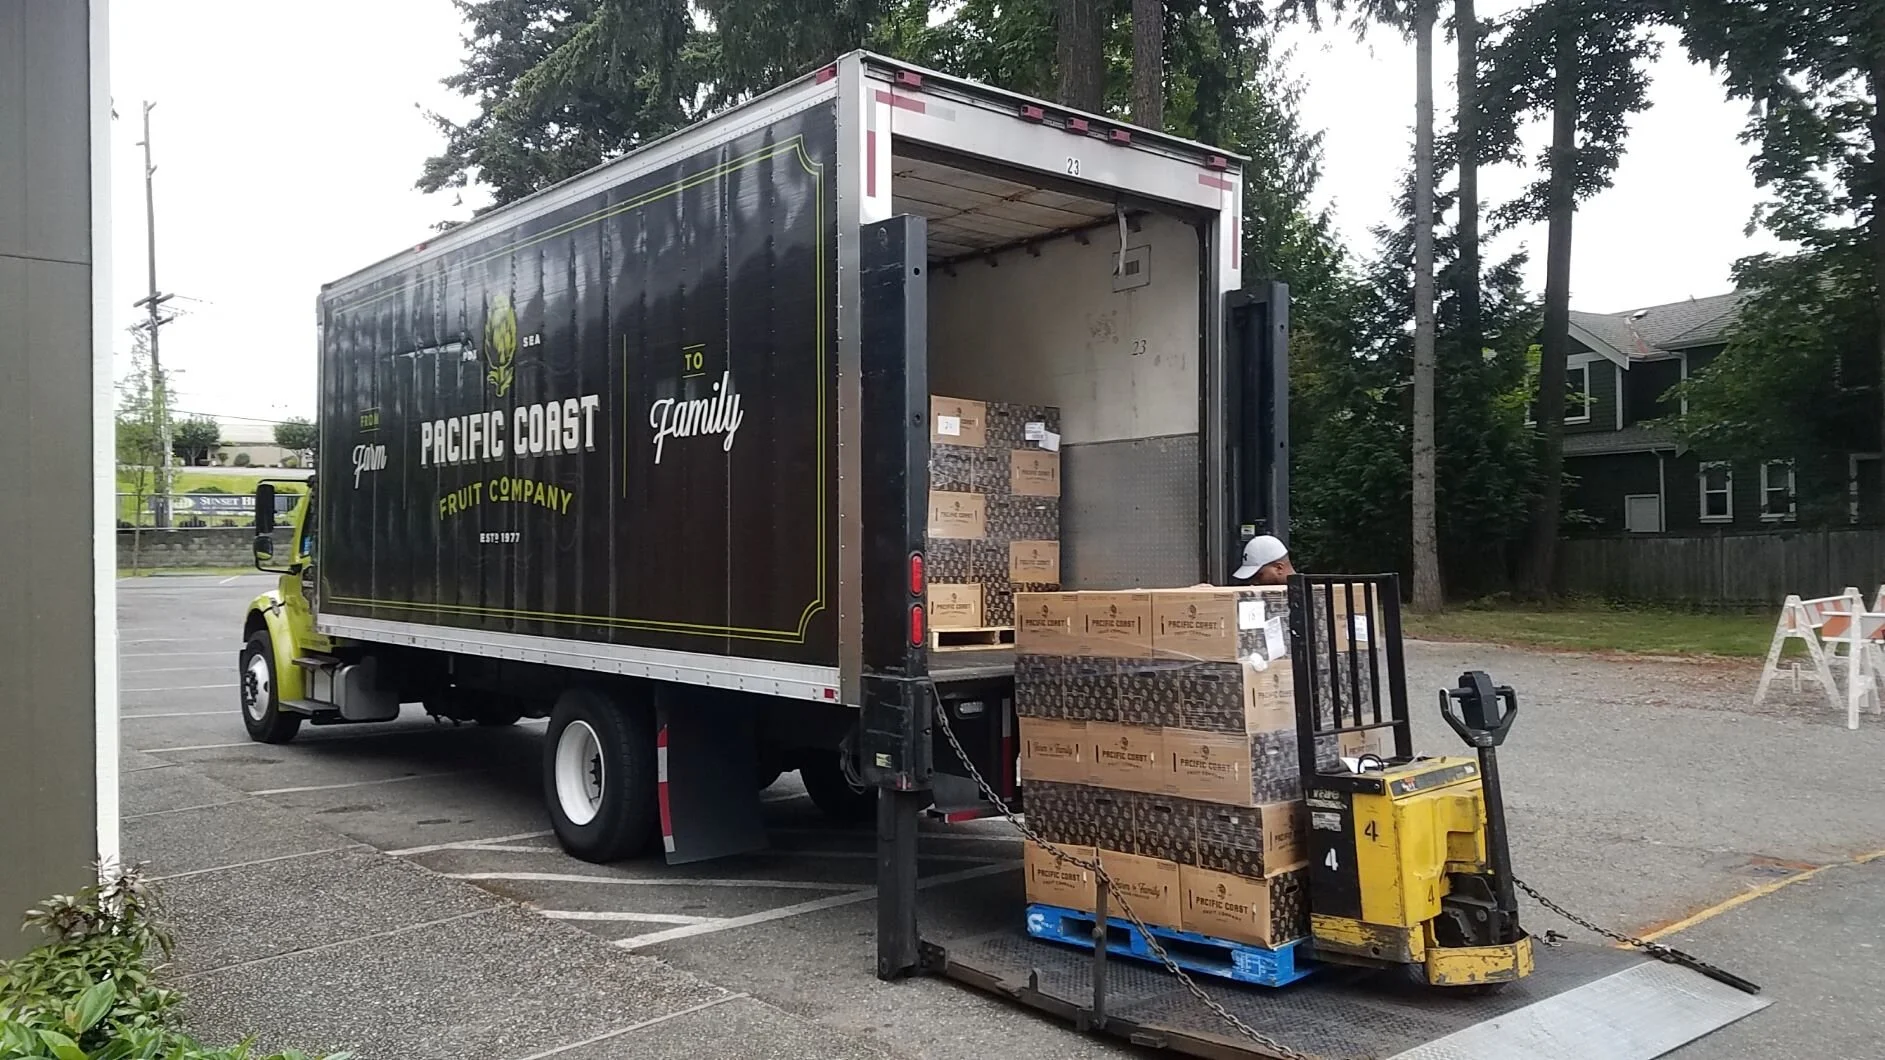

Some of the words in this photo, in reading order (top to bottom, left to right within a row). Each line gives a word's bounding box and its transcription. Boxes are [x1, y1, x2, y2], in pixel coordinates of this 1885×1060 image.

[1067, 158, 1080, 176] 23
[523, 334, 541, 347] SEA
[1131, 340, 1147, 356] 23
[685, 351, 704, 371] TO
[649, 370, 744, 464] Family
[420, 411, 505, 468] PACIFIC
[514, 394, 600, 459] COAST
[352, 443, 388, 489] Farm
[200, 496, 240, 506] SUNSET
[241, 496, 256, 506] HI
[438, 482, 482, 520] FRUIT
[489, 476, 572, 515] COMPANY
[500, 532, 521, 543] 1977
[1364, 820, 1379, 842] 4
[1324, 847, 1339, 871] 4
[1195, 896, 1223, 909] PACIFIC
[1224, 902, 1248, 915] COAST
[1427, 884, 1436, 907] 4
